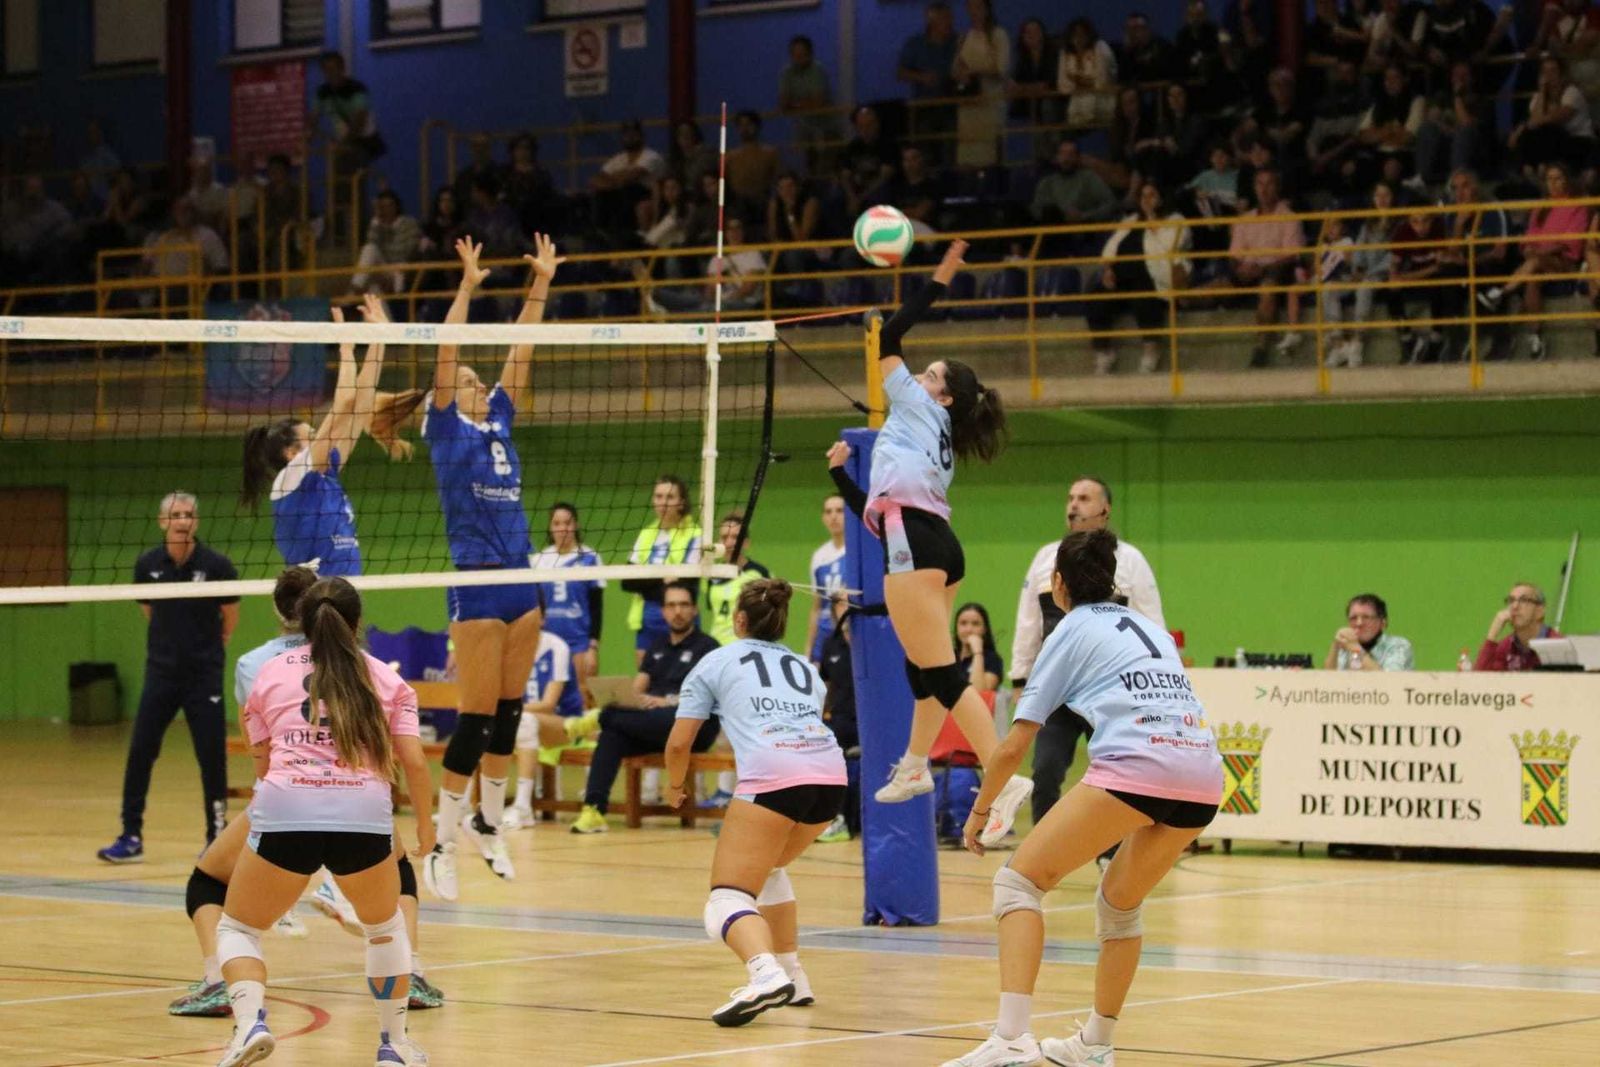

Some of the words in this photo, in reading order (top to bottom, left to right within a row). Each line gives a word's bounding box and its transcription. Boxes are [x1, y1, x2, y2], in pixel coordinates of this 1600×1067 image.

[1115, 616, 1162, 659] 1
[739, 650, 813, 696] 10
[1270, 686, 1390, 707] Ayuntamiento
[1404, 688, 1516, 711] Torrelavega
[1321, 724, 1462, 748] INSTITUTO
[1319, 759, 1463, 784] MUNICIPAL
[1300, 794, 1335, 816] DE
[1343, 795, 1482, 821] DEPORTES
